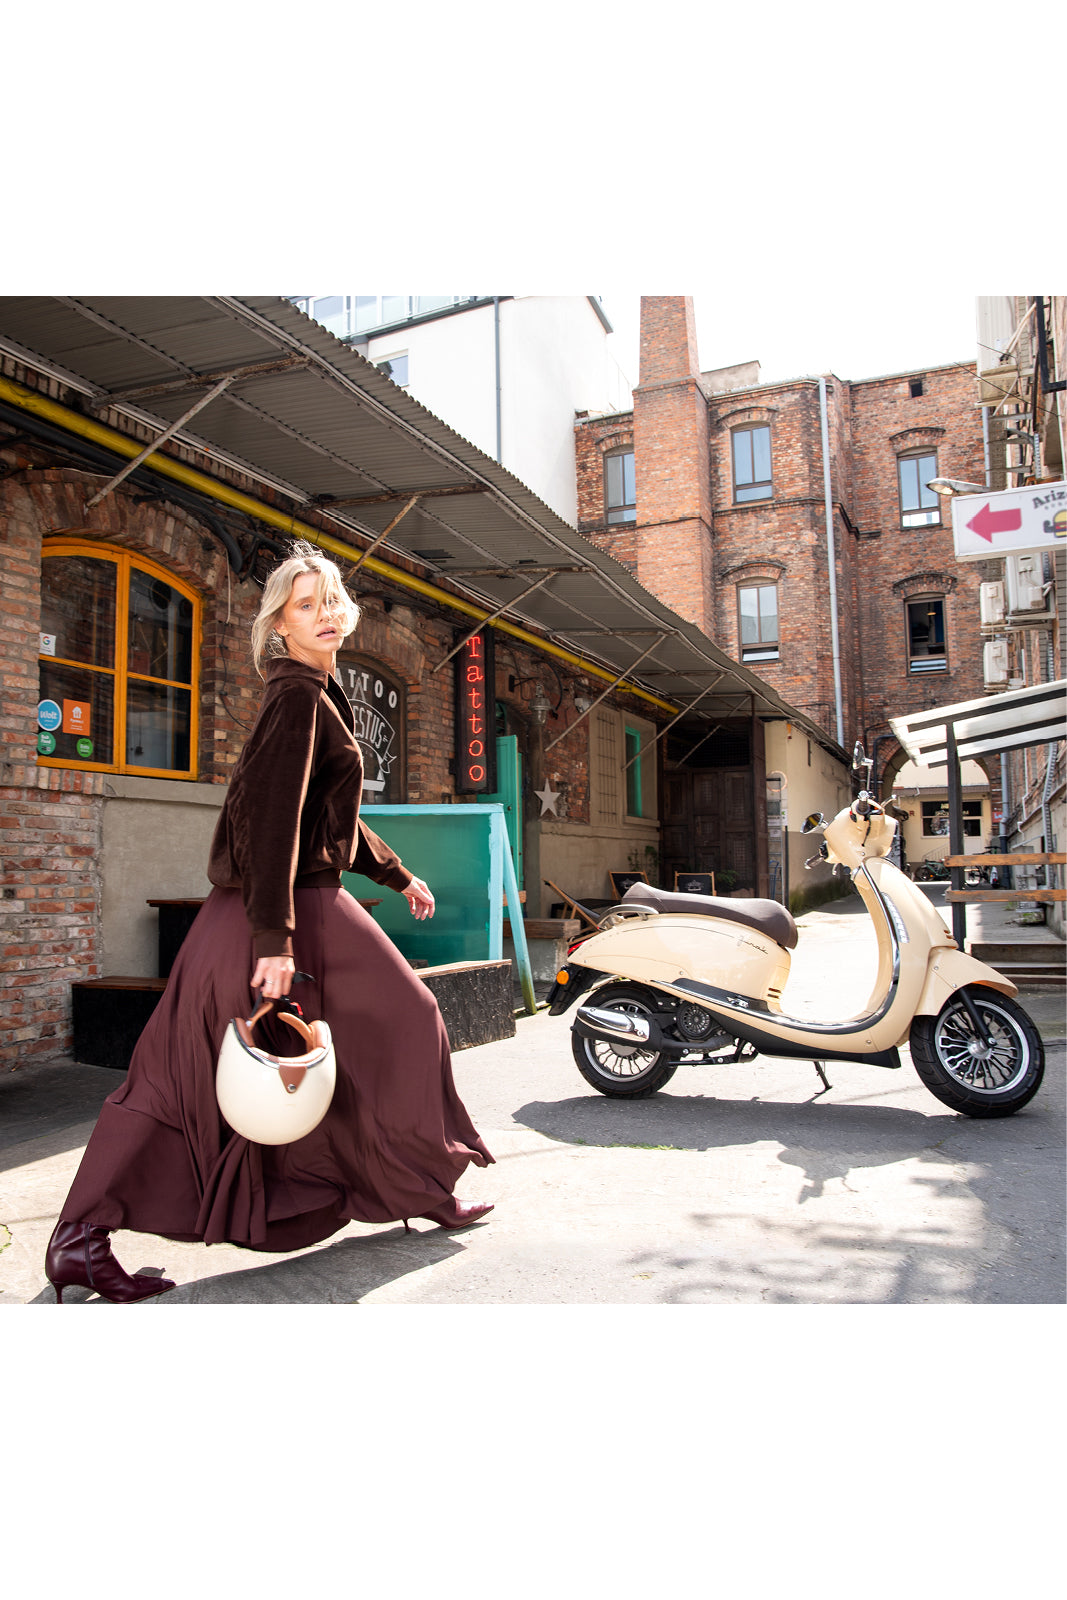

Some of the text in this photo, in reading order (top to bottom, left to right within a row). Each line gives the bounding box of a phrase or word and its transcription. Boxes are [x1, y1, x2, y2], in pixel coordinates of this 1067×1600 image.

[1032, 490, 1067, 510] Ariz
[335, 667, 398, 709] ATTOO
[466, 636, 484, 782] Tattoo
[40, 710, 58, 720] Wolt
[353, 705, 386, 749] ESTUS
